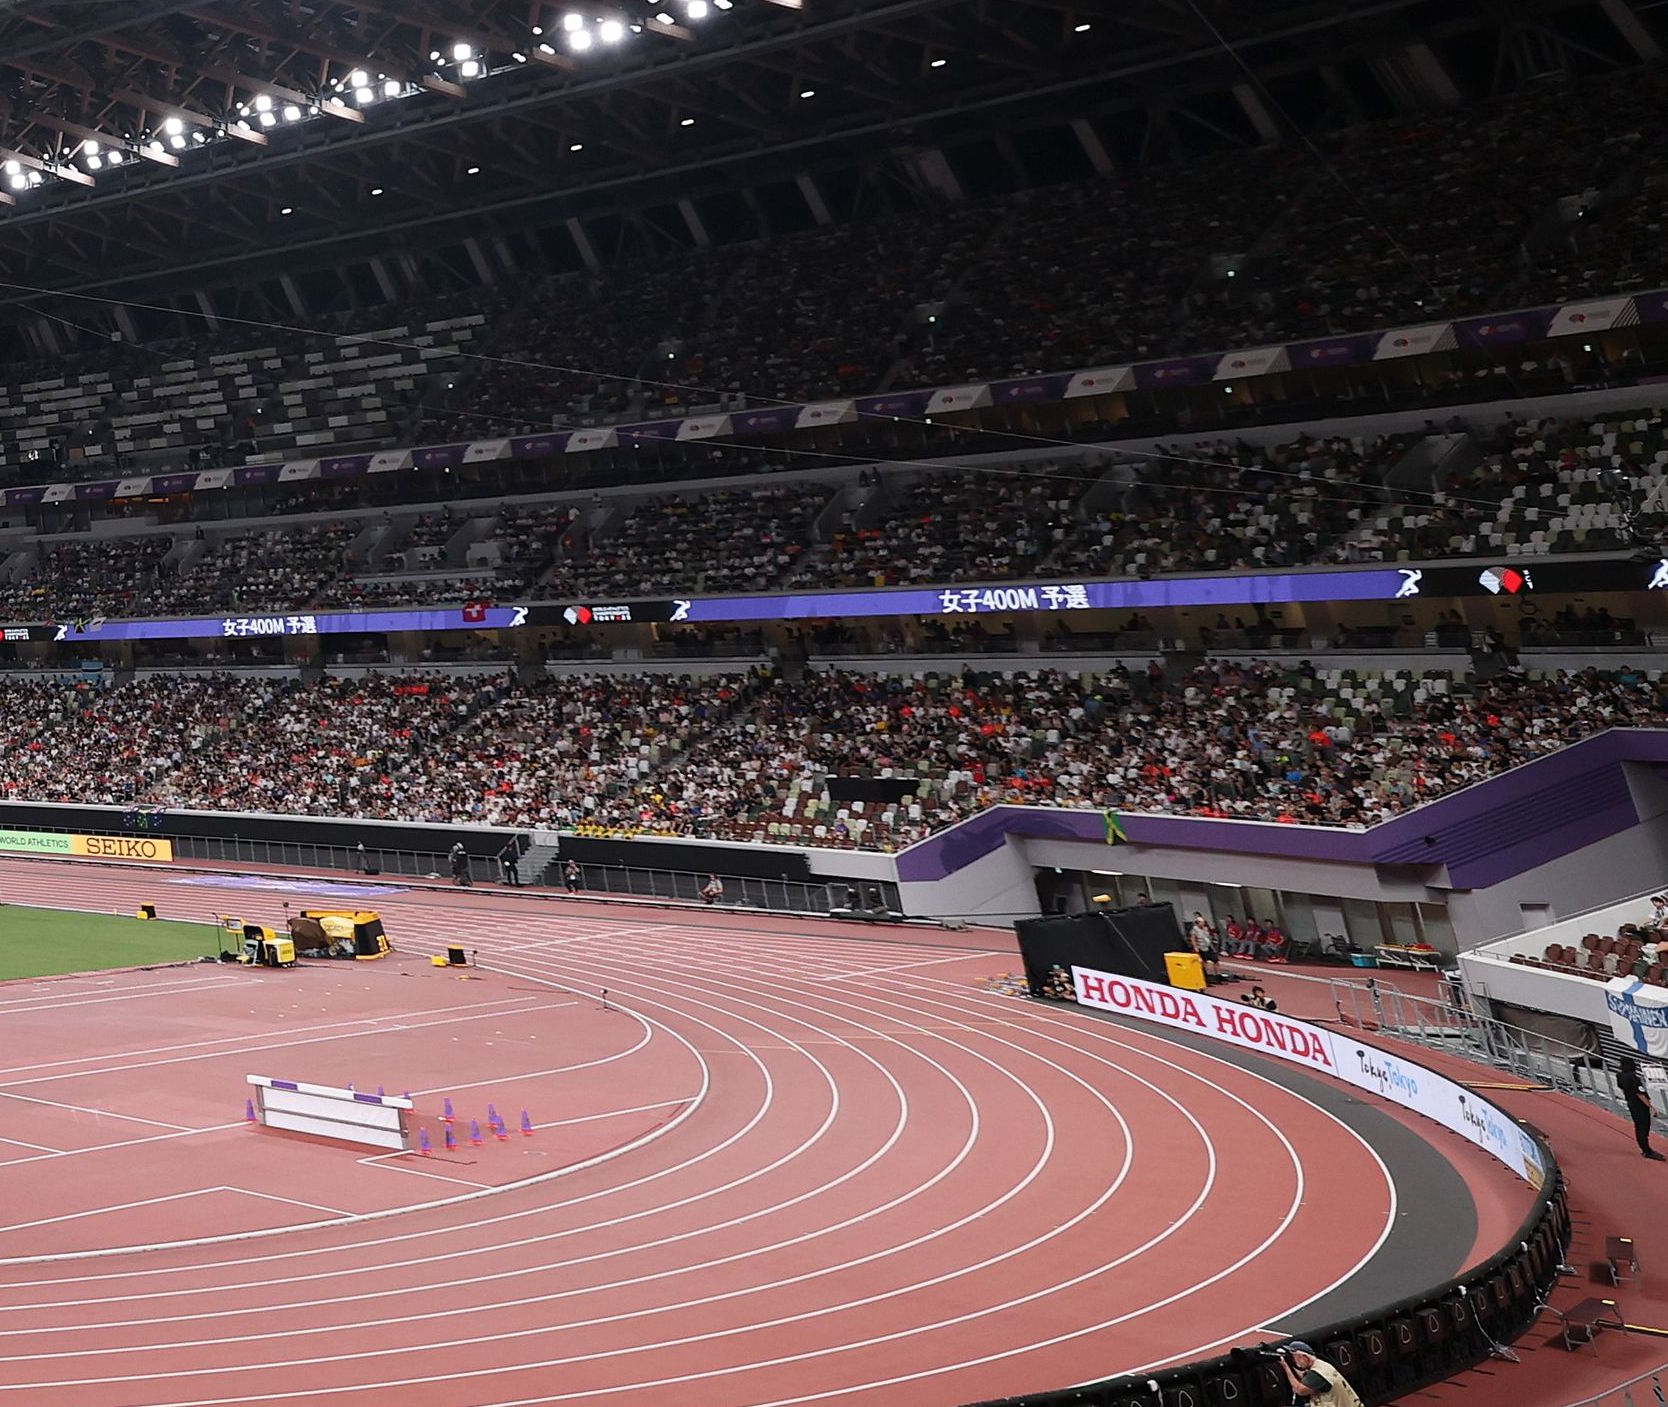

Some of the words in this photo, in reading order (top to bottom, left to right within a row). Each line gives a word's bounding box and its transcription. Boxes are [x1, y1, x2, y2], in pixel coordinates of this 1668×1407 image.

[939, 589, 1039, 612] 女子400M
[222, 618, 285, 636] 女子400M
[28, 837, 69, 849] ATHLETICS
[86, 837, 157, 858] SEIKO
[1079, 974, 1207, 1028] HONDA
[1211, 1004, 1332, 1067] HONDA
